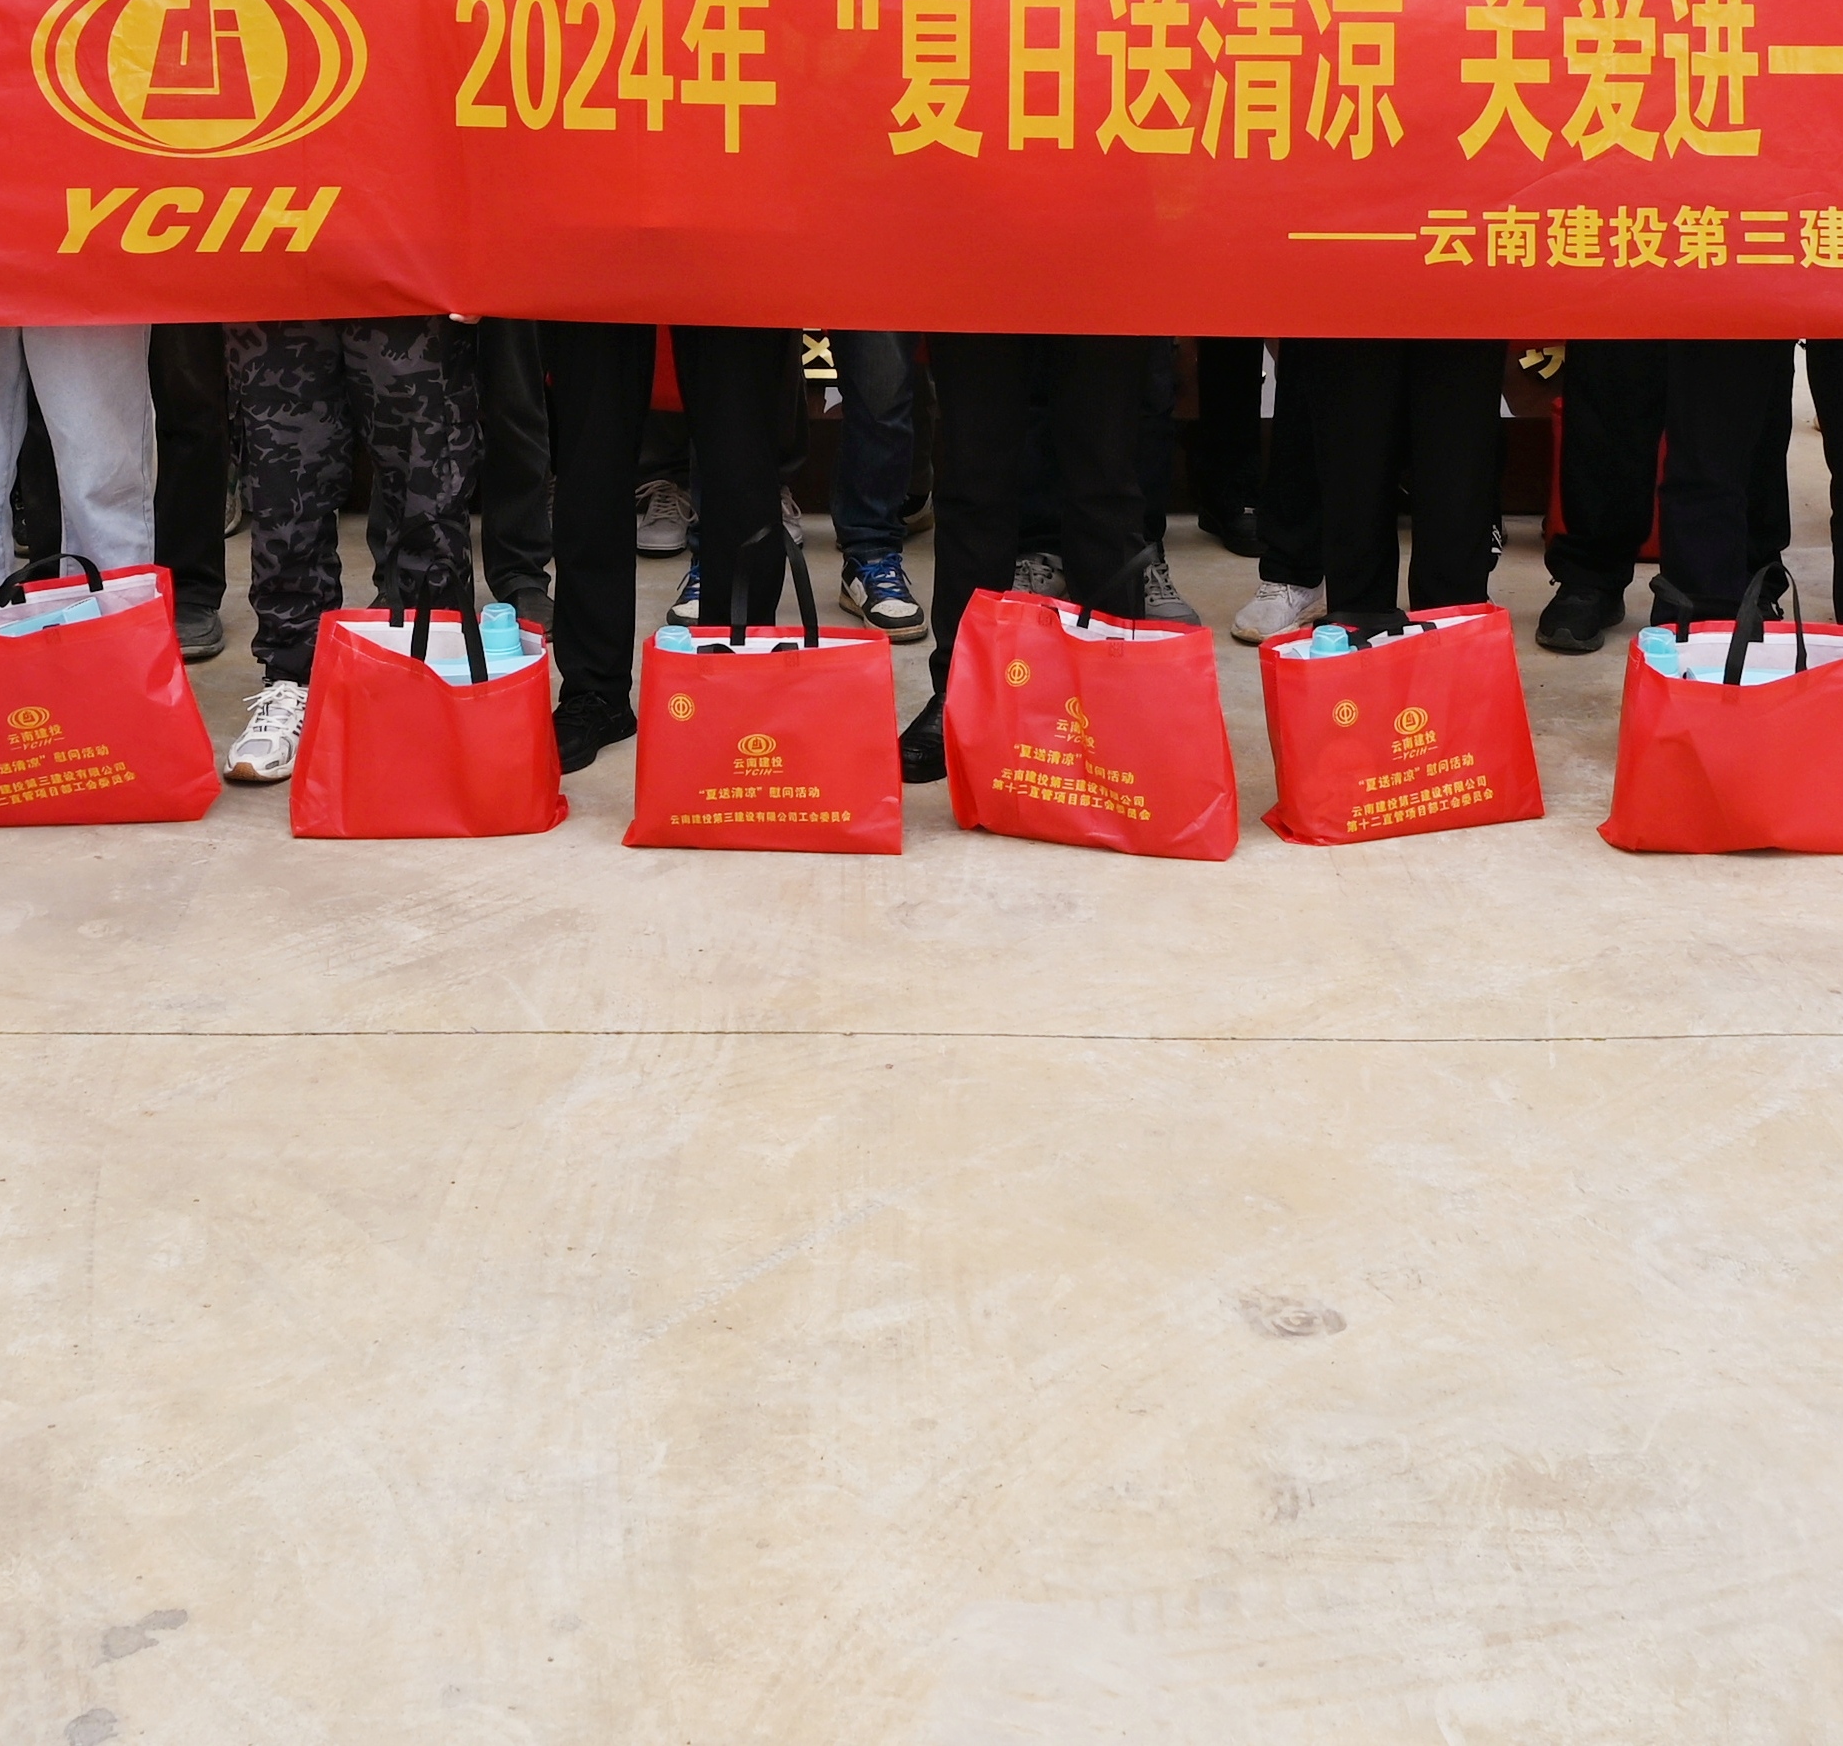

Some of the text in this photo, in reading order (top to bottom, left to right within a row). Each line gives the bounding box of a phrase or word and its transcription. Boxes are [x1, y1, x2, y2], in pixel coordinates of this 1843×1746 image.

[56, 187, 343, 254] YCIH
[8, 724, 63, 745] 云南建投
[1391, 729, 1437, 753] 云南建投
[53, 744, 110, 763] 慰问活动
[733, 756, 783, 769] 云南建投
[1403, 747, 1428, 760] YCIH
[744, 768, 773, 776] YCIH
[1426, 752, 1475, 777] 慰问活动
[769, 786, 821, 799] 慰问活动
[1351, 775, 1487, 818] 云南建投第三建设有限公司
[670, 810, 851, 825] 云南建投第三建设有限公司工会委员会
[1346, 788, 1494, 833] 第十二直管项目部工会委员会
